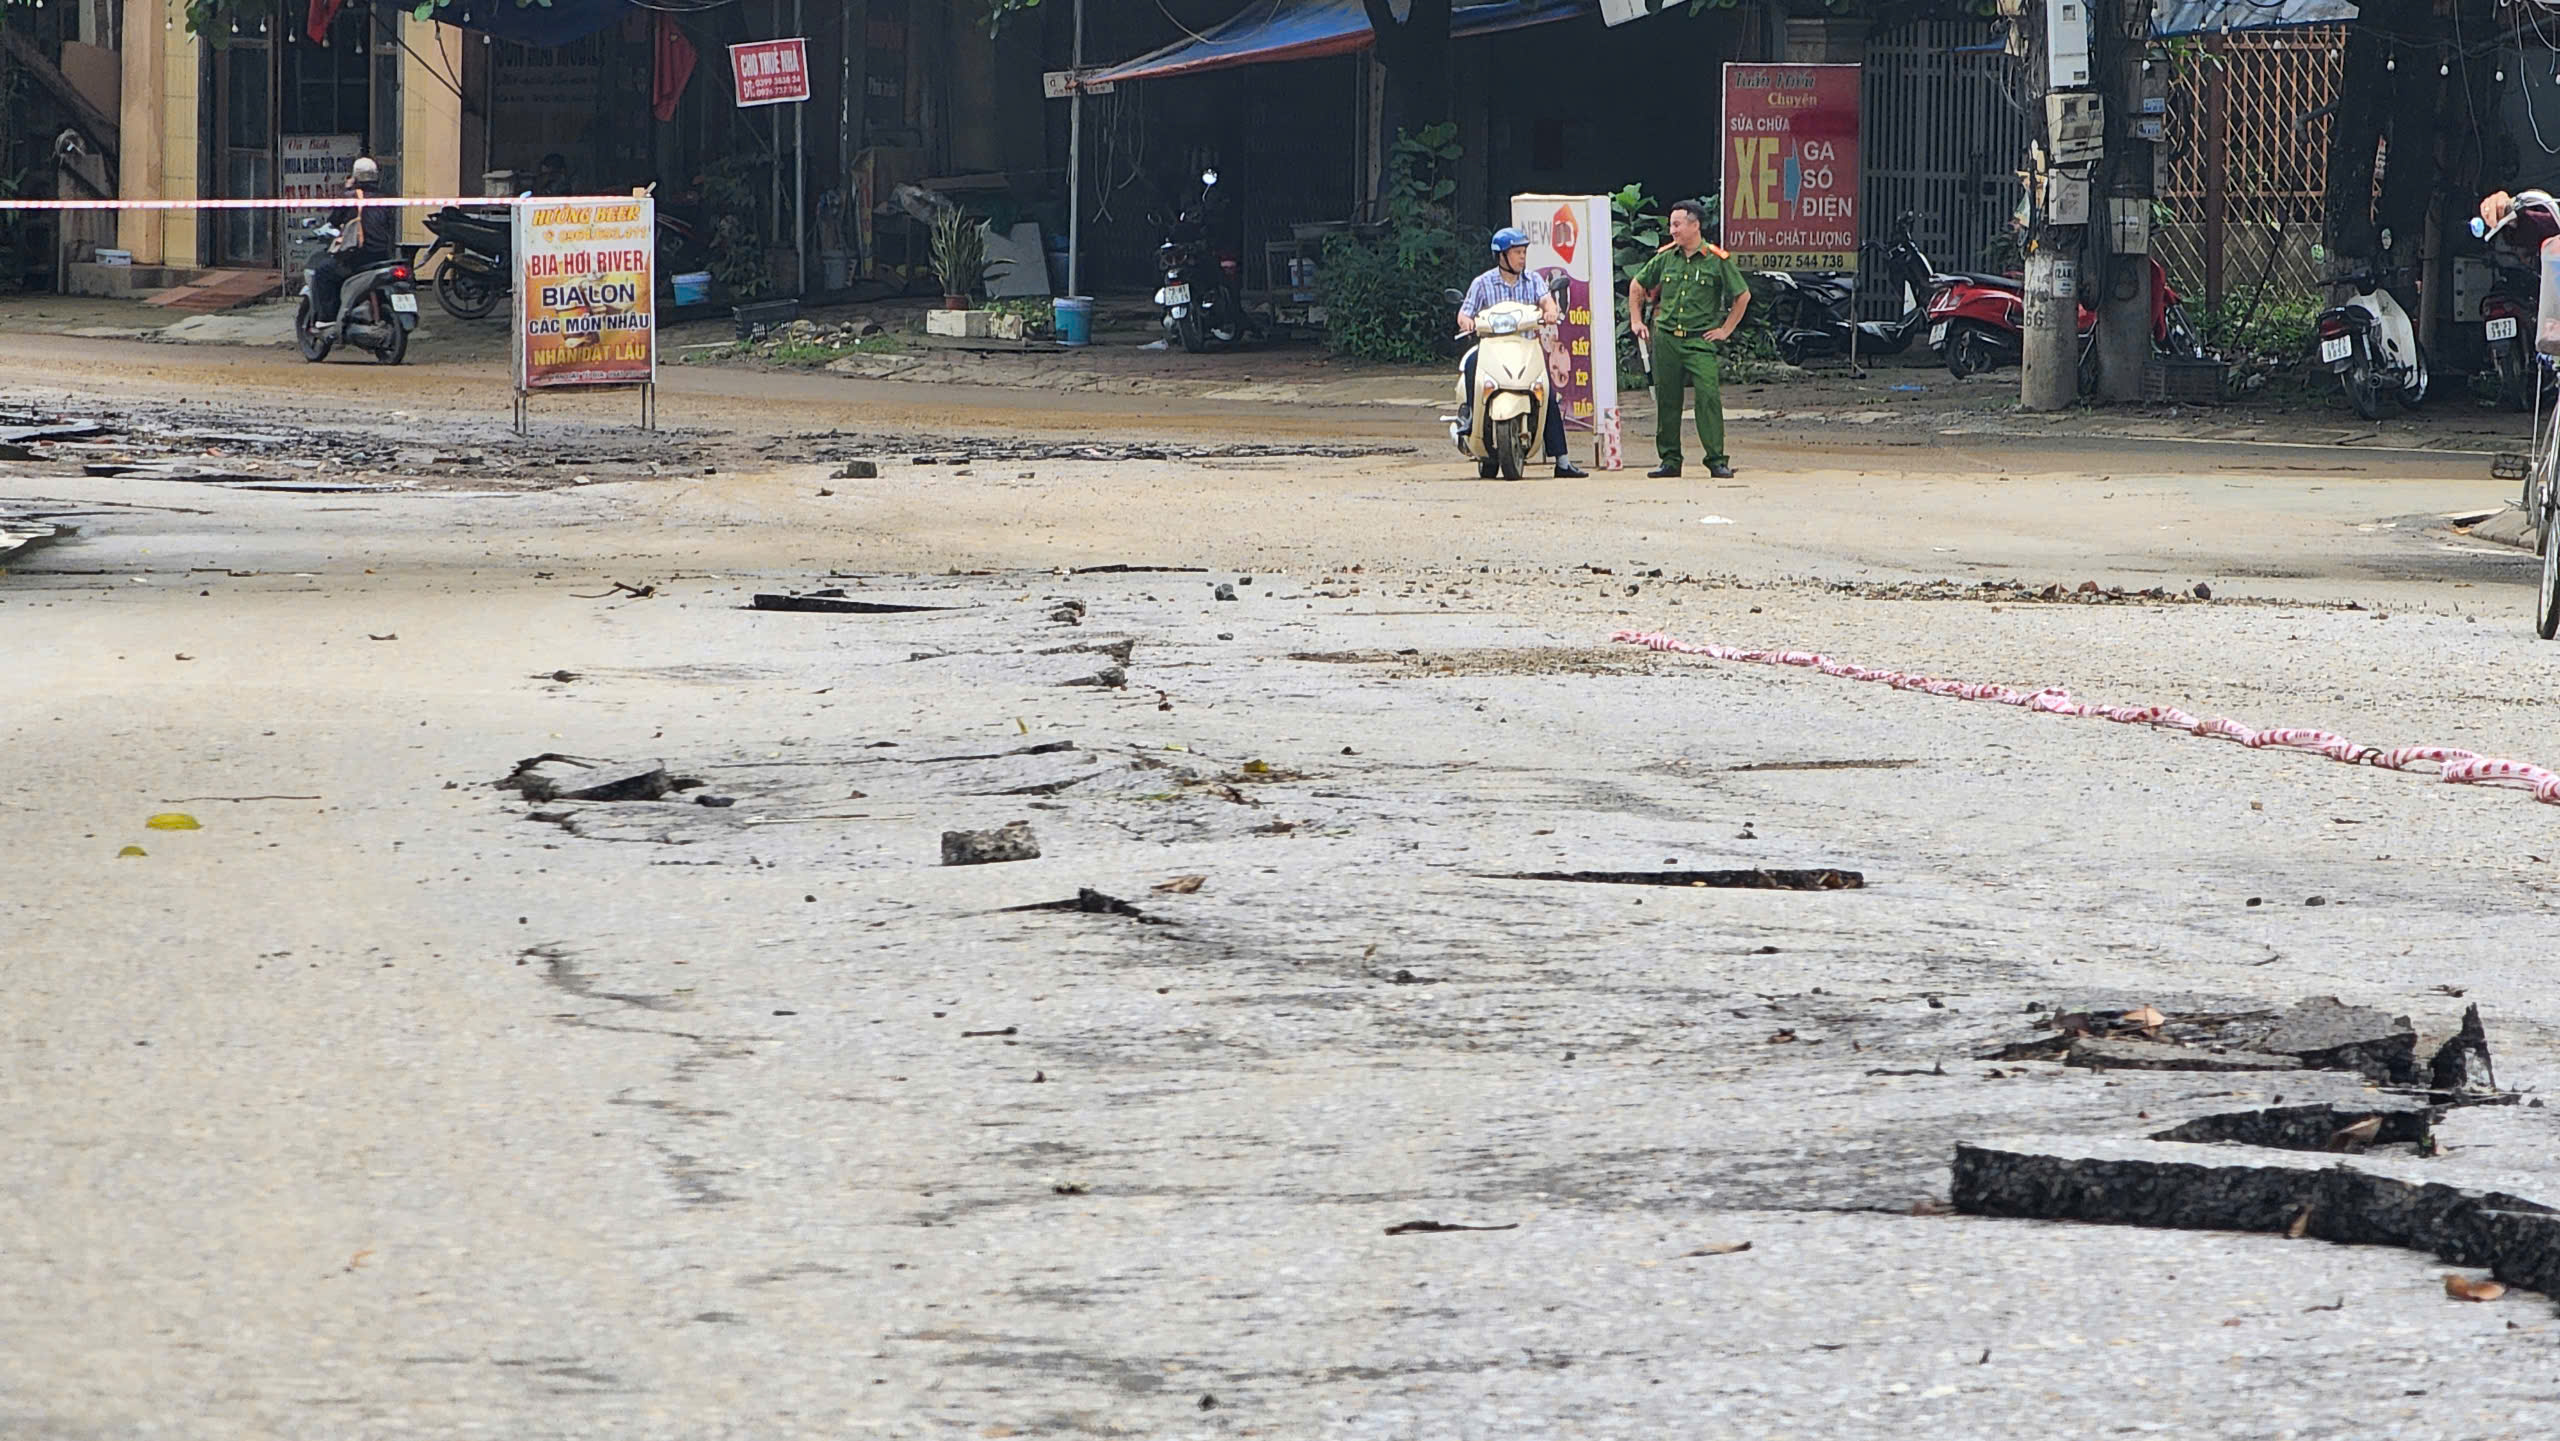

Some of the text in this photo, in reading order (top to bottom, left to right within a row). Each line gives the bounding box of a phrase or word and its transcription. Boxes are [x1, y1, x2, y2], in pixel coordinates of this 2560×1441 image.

[740, 44, 799, 78] CHO THUÊ NHÀ
[1730, 113, 1790, 132] SỬA CHỮA
[1803, 140, 1835, 161] GA
[1732, 137, 1779, 220] XE
[594, 204, 641, 222] BEER
[1802, 193, 1852, 222] ĐIỆN
[1521, 220, 1552, 246] NEW
[1730, 231, 1745, 246] UY
[1748, 227, 1766, 246] TÍN
[1776, 229, 1806, 246] CHẤT
[1809, 231, 1851, 249] LƯỢNG
[531, 249, 644, 276] BIA HƠI RIVER
[1762, 254, 1792, 267] 0972
[1796, 254, 1817, 267] 544
[1822, 254, 1844, 267] 738
[542, 284, 635, 307] BIA LON
[529, 311, 650, 335] CÁC MÓN NHẬU
[1575, 368, 1589, 386] ÉP
